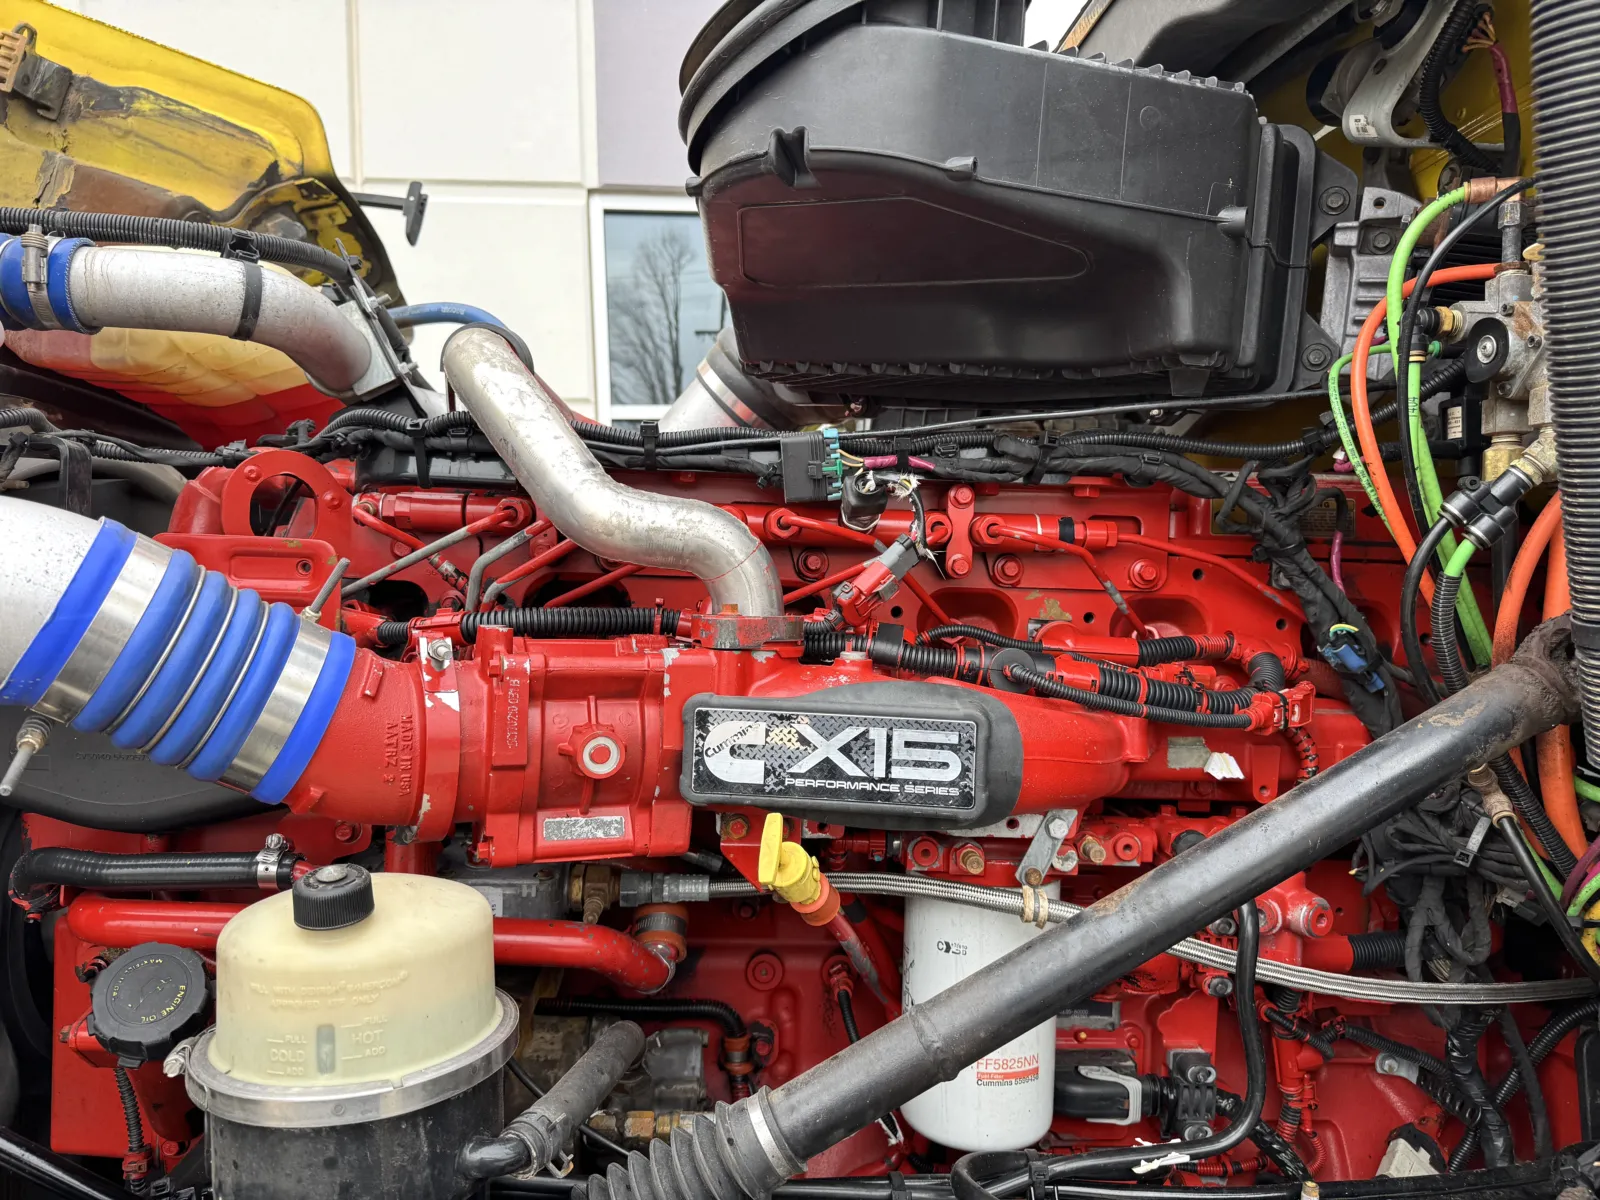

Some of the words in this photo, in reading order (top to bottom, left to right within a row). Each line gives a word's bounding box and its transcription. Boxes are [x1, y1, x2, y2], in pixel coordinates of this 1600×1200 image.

[400, 714, 414, 751] MADE
[704, 721, 761, 758] Cummins
[786, 723, 962, 782] X15
[400, 755, 412, 772] IN
[399, 774, 412, 797] USA
[784, 777, 900, 793] PERFORMANCE
[903, 784, 960, 796] SERIES
[161, 984, 187, 1017] ENGINE
[140, 1014, 157, 1024] OIL
[284, 1035, 308, 1044] FULL
[352, 1029, 385, 1045] HOT
[269, 1048, 306, 1063] COLD
[365, 1046, 386, 1056] ADD
[976, 1052, 1039, 1071] FF5825NN
[286, 1067, 305, 1076] ADD
[976, 1079, 1013, 1087] Cummins
